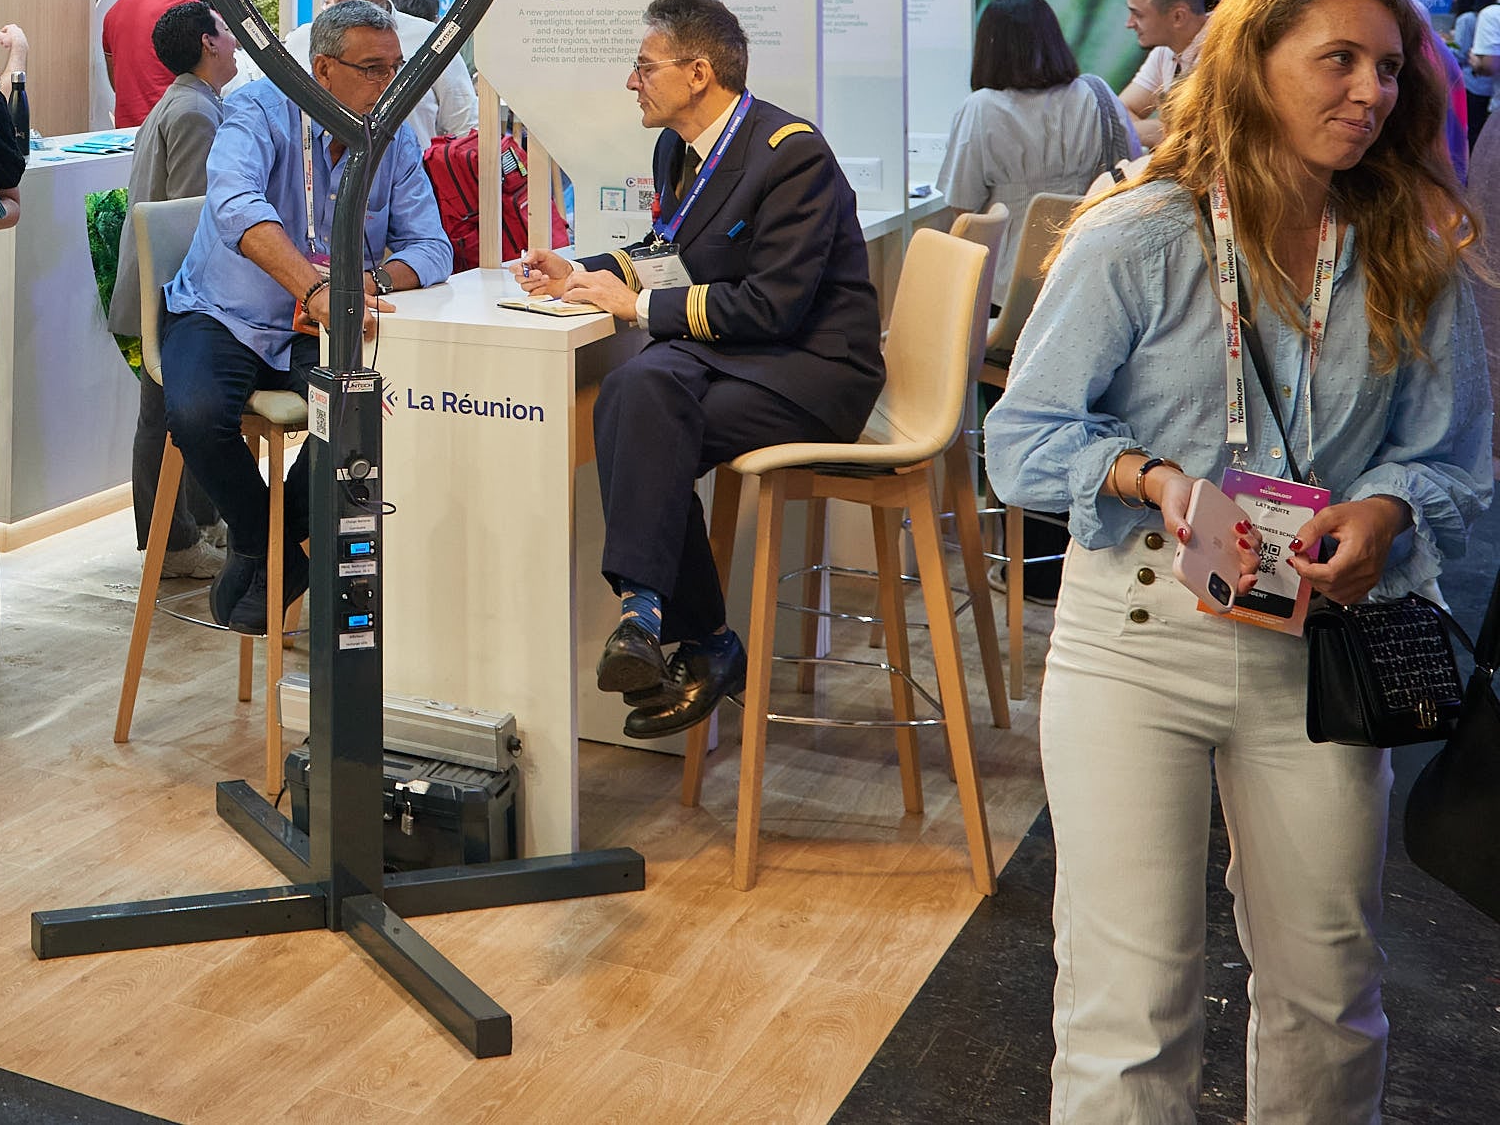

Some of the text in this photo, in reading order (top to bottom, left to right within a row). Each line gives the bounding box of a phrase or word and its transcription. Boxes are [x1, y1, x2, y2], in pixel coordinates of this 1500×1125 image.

[544, 9, 584, 17] generation
[536, 27, 551, 35] and
[553, 28, 574, 36] ready
[576, 27, 586, 35] for
[612, 27, 633, 35] cities
[532, 46, 556, 54] added
[557, 46, 588, 54] features
[577, 55, 606, 63] electric
[1226, 238, 1236, 284] TECHNOLOGY
[1314, 259, 1324, 302] TECHNOLOGY
[406, 388, 544, 422] La Réunion
[1236, 377, 1244, 424] TECHNOLOGY
[1279, 531, 1296, 539] SCHO
